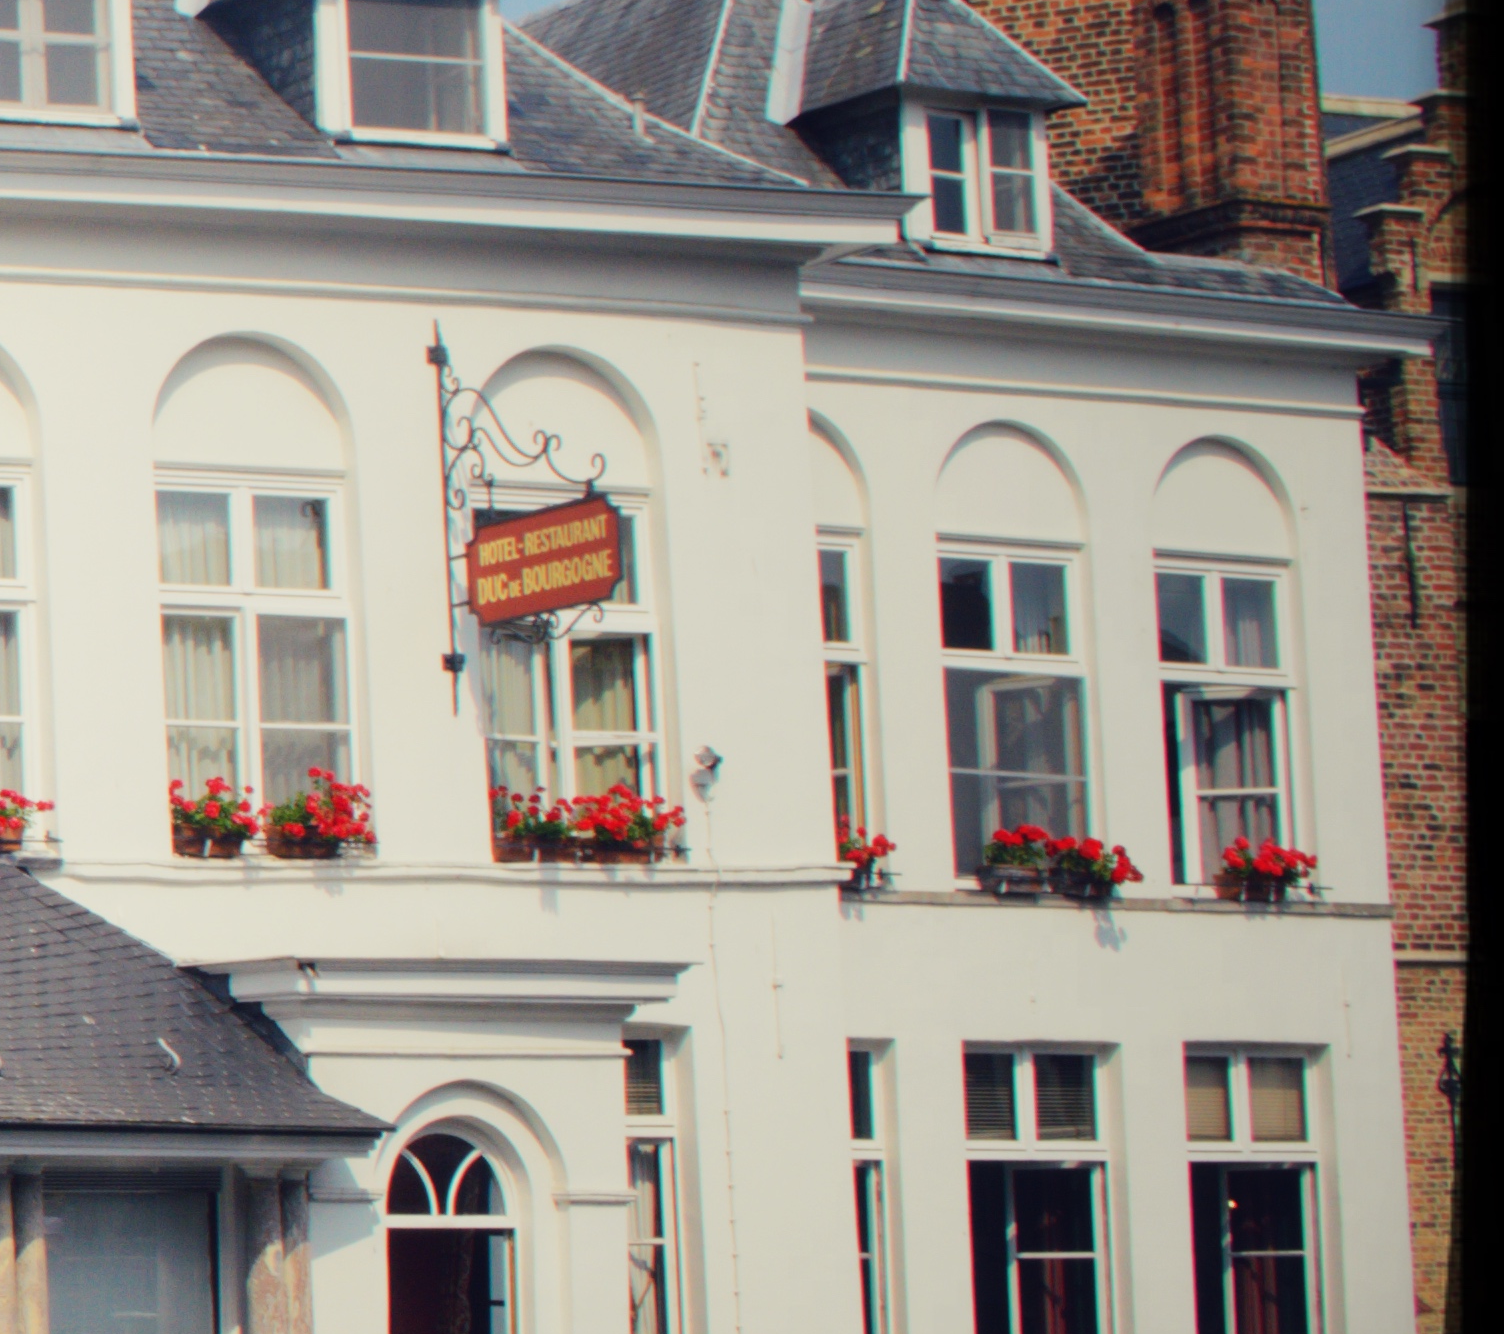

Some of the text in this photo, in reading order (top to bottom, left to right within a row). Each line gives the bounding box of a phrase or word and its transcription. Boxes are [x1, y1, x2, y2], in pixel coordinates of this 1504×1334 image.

[478, 515, 608, 566] HOTEL-RESTAURANT
[477, 573, 508, 605] DUC
[523, 550, 612, 595] BOURGOGNE
